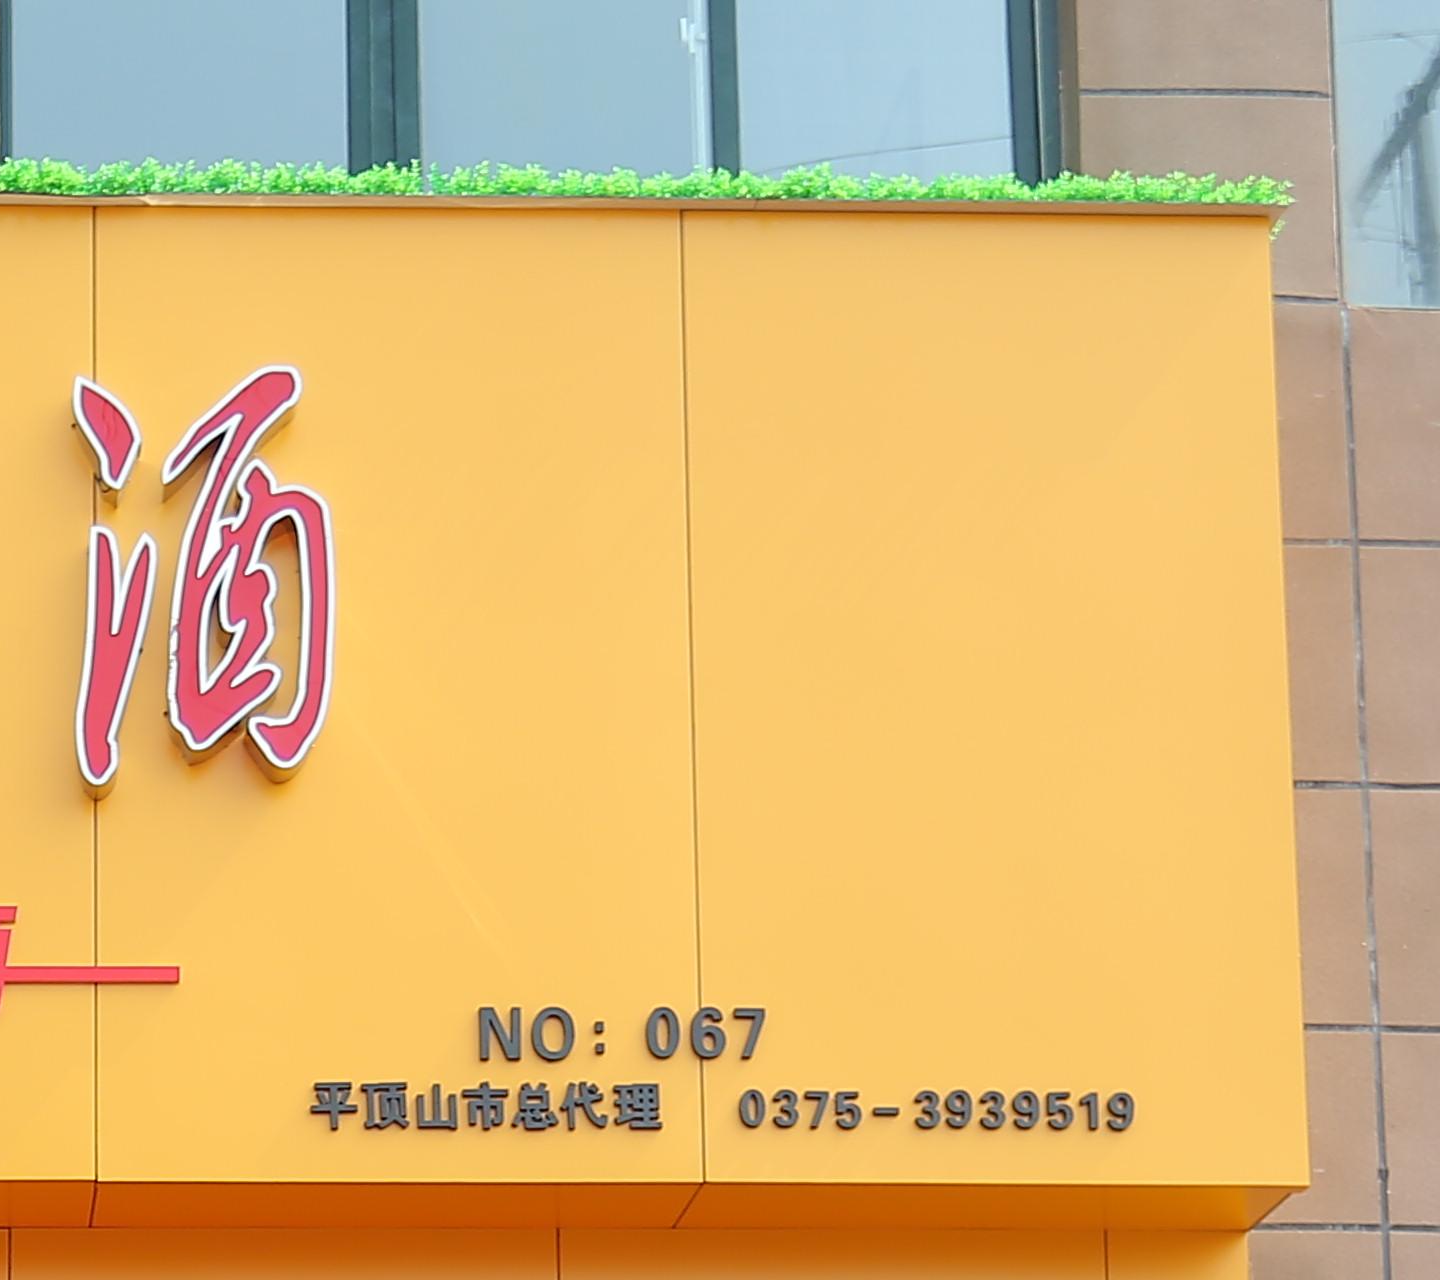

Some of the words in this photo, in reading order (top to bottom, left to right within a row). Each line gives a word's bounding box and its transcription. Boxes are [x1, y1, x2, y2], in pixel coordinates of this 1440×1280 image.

[645, 1007, 766, 1059] 067
[310, 1082, 662, 1131] 平顶山市总代理
[739, 1089, 1135, 1132] 0375-3939519
